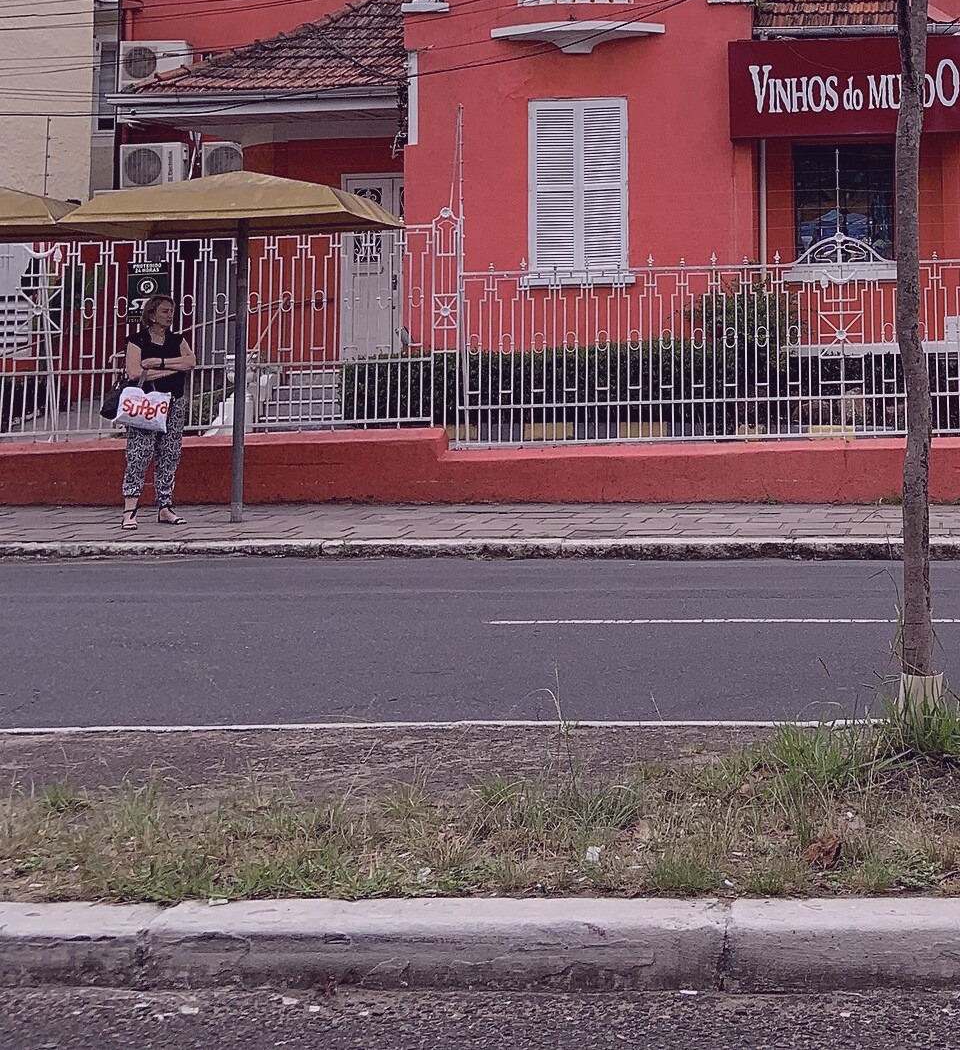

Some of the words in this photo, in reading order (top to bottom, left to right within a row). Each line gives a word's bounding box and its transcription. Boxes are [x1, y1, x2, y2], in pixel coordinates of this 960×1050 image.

[748, 65, 839, 114] VINHOS
[843, 76, 863, 111] do
[867, 59, 960, 110] MUDO
